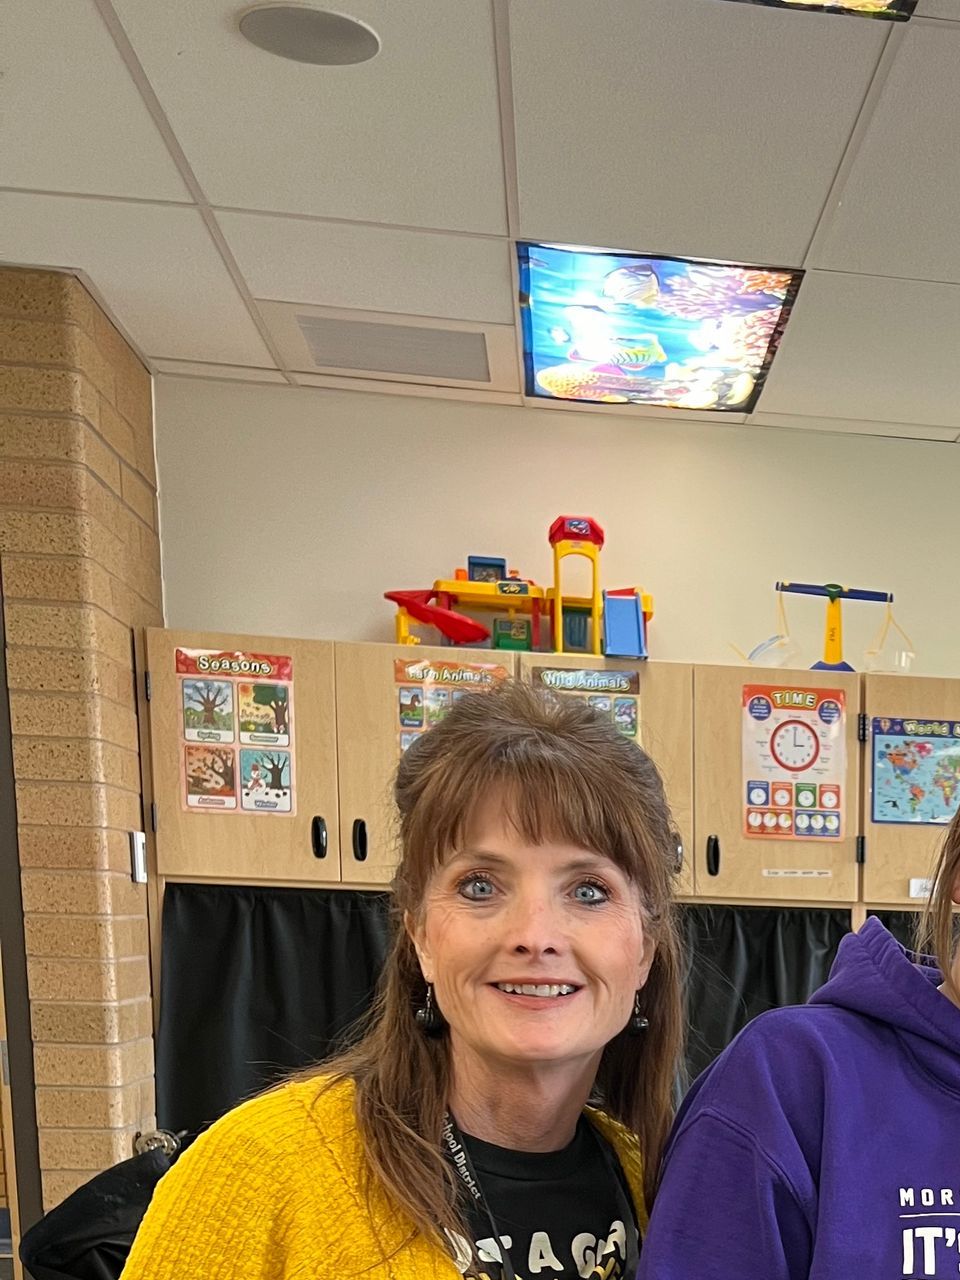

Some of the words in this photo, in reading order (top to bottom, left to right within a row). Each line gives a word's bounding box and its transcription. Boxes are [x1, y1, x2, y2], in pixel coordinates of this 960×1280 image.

[198, 655, 272, 674] Seasons
[543, 671, 575, 688] Wild
[576, 673, 630, 690] Animals
[773, 691, 816, 707] TIME
[904, 720, 950, 735] World
[454, 1151, 482, 1200] District
